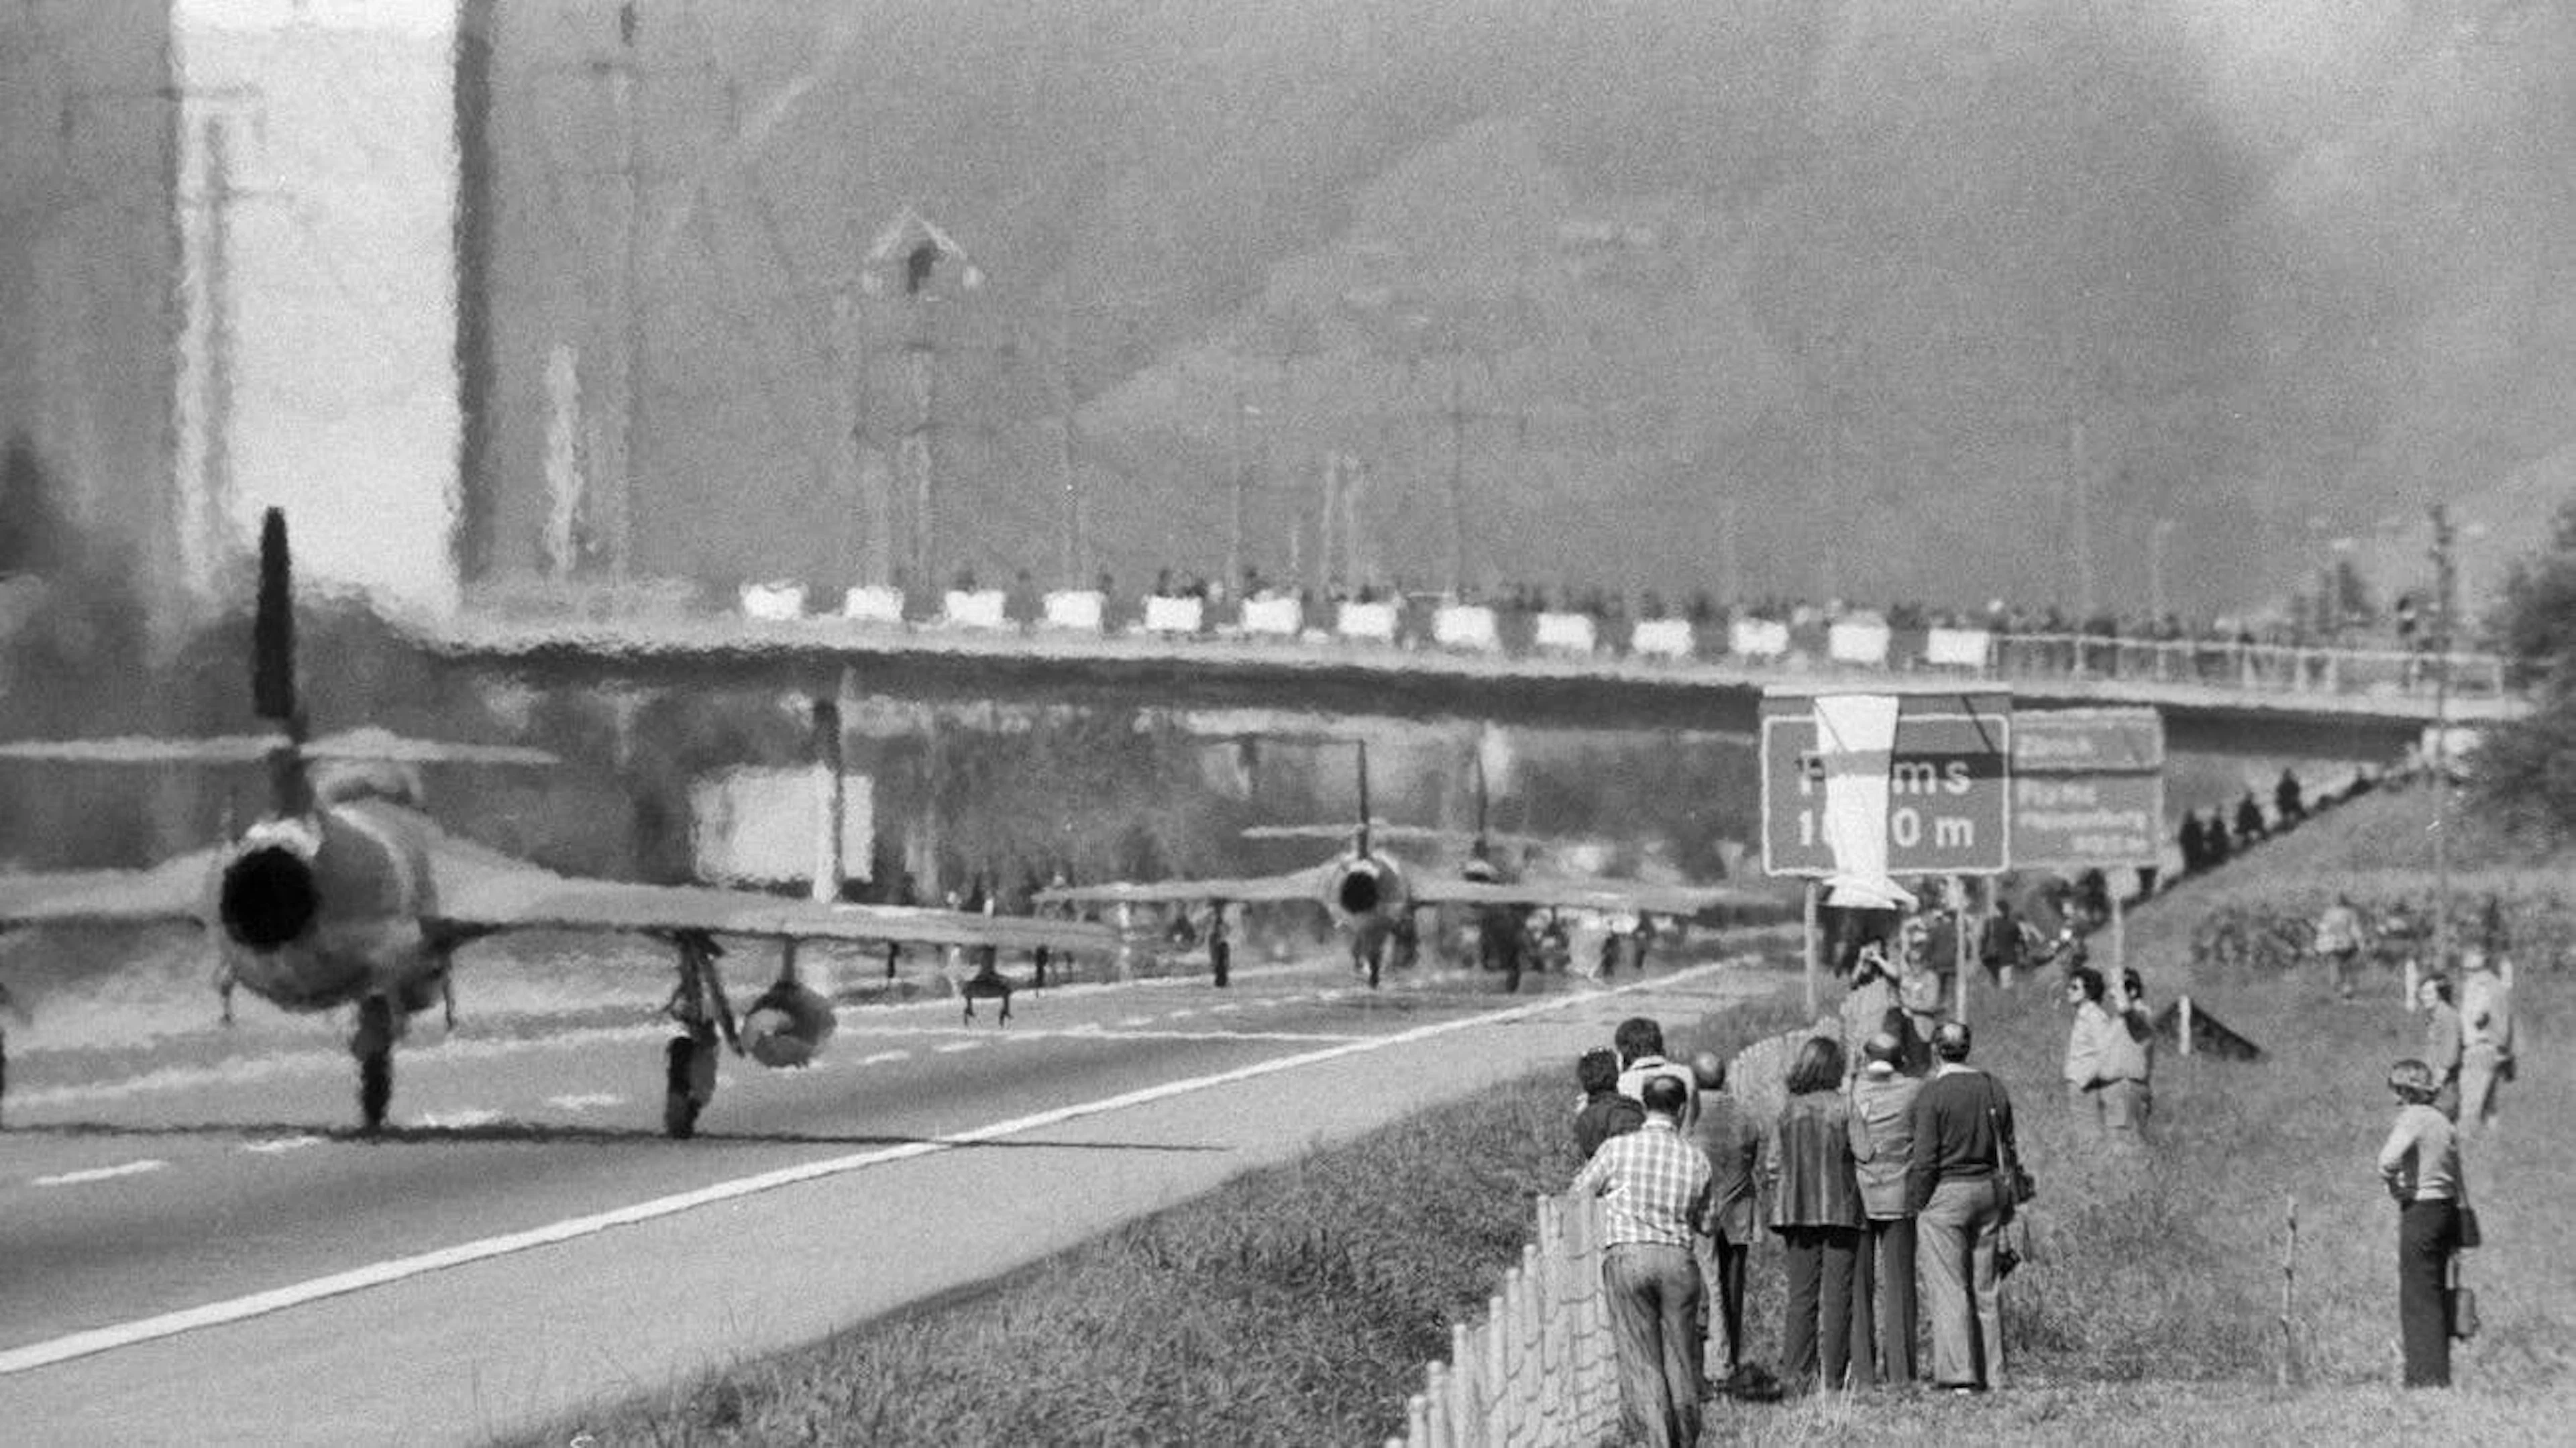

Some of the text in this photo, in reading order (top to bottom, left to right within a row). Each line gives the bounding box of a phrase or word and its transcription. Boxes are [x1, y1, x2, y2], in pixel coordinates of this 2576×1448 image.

[1800, 750, 1971, 795] Fms
[1798, 807, 1974, 848] 10 m
